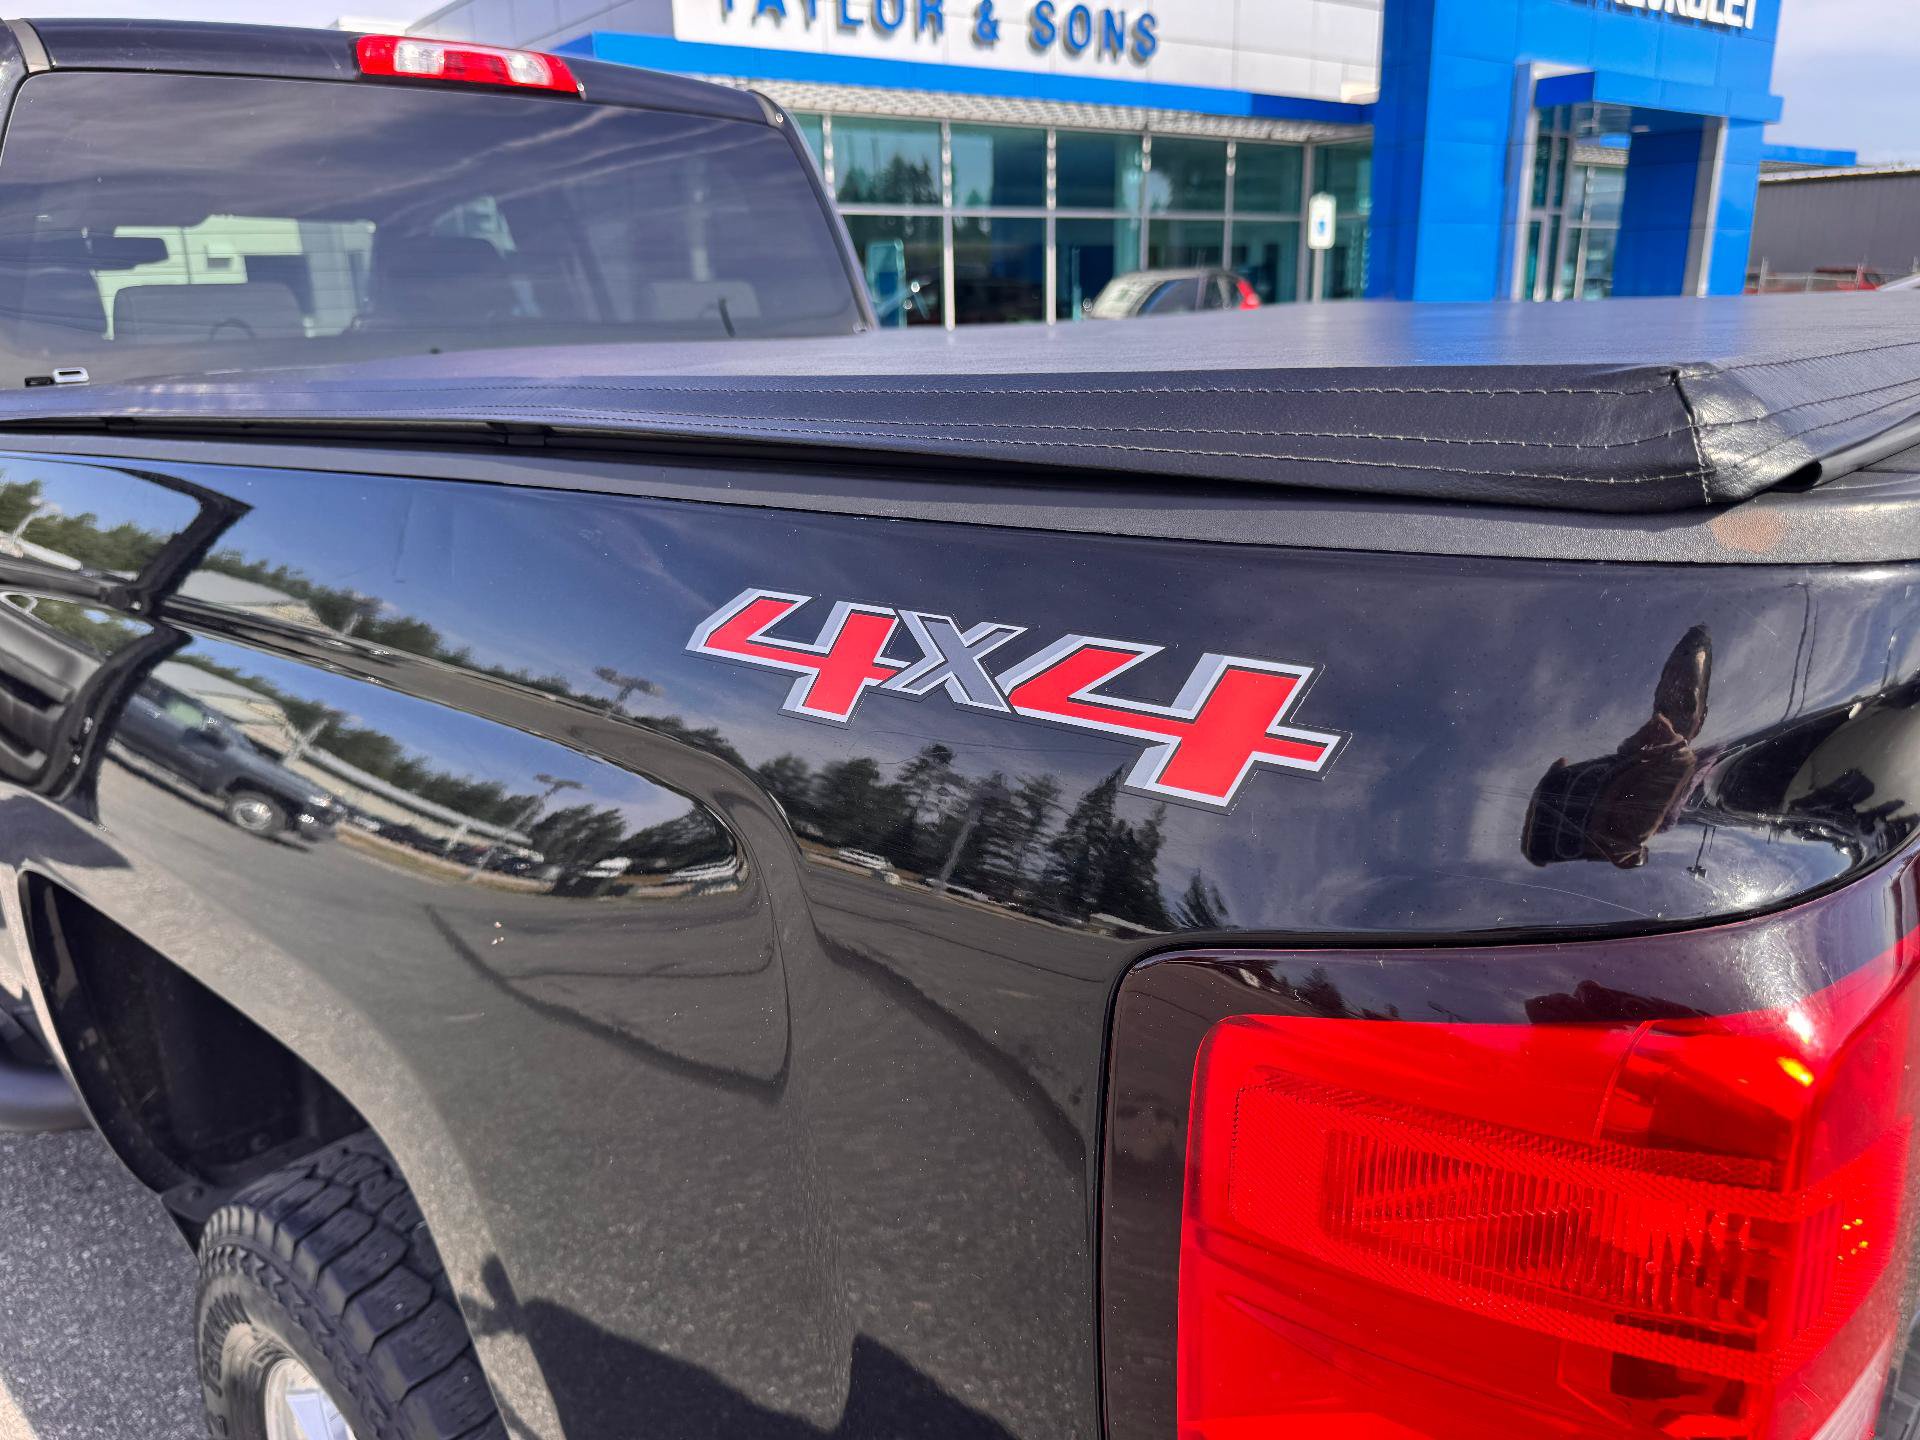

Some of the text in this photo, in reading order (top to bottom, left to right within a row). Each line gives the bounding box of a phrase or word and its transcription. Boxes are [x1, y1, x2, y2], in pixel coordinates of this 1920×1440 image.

[725, 0, 1157, 59] LOR & SONS
